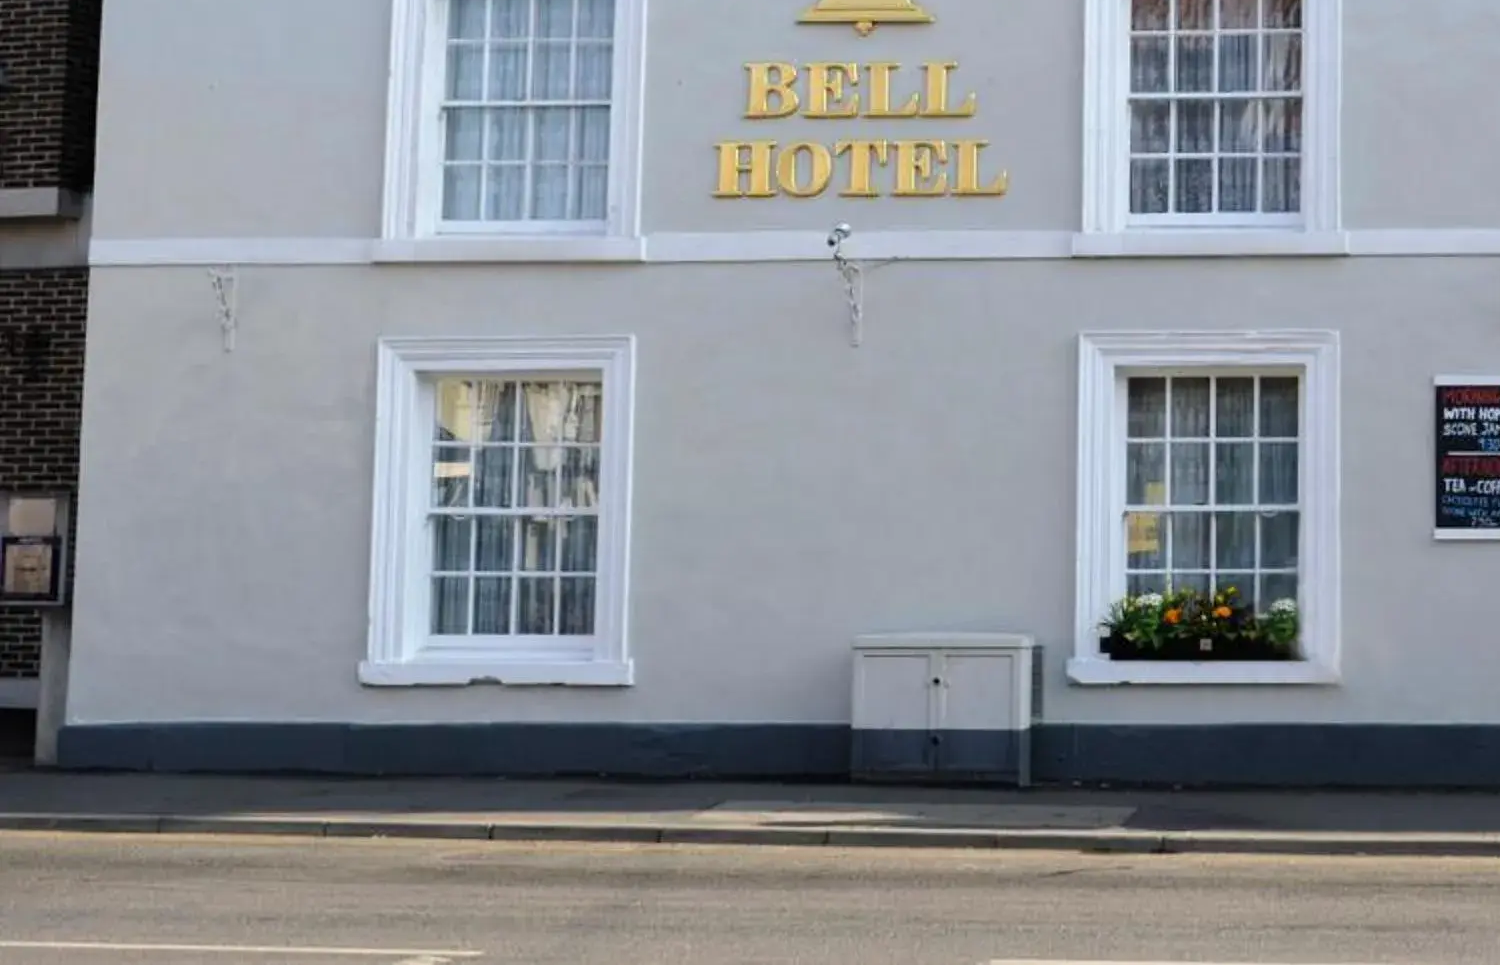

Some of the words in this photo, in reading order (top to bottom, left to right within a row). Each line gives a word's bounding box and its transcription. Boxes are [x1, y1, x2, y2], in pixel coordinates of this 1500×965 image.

[743, 61, 976, 119] BELL
[711, 139, 1008, 198] HOTEL
[1443, 406, 1475, 420] WITH
[1443, 422, 1478, 436] SCONE
[1443, 478, 1466, 494] TEA
